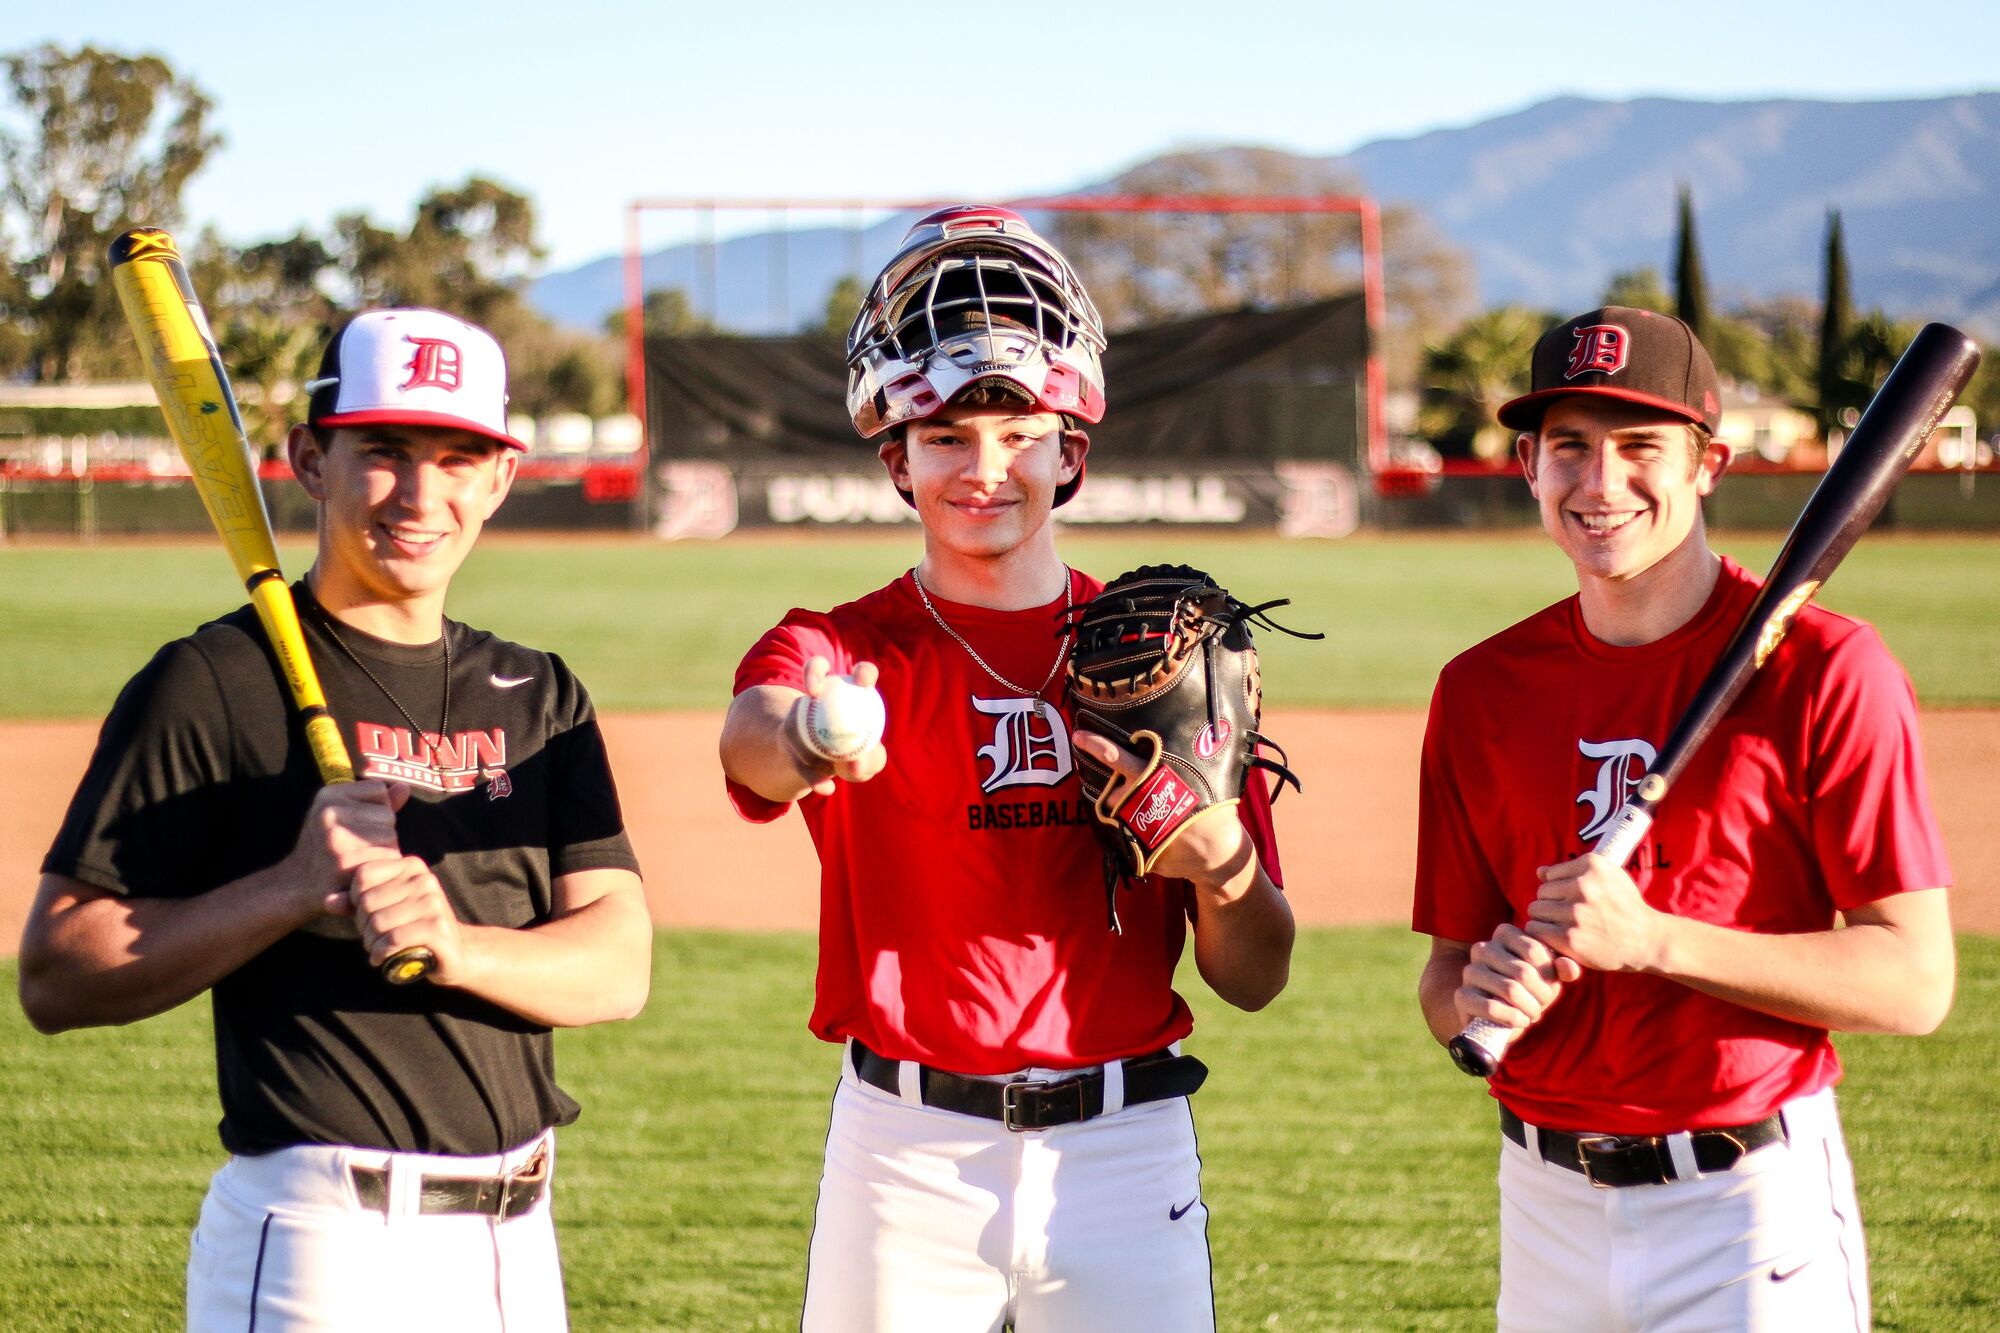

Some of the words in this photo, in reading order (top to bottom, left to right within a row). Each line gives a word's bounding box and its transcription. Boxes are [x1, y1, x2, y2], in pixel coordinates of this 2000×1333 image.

[397, 334, 463, 393] D
[1564, 325, 1629, 381] D
[356, 721, 507, 771] DUNN
[972, 695, 1073, 794] D
[378, 763, 462, 787] BASEBAL
[1137, 780, 1175, 829] Rawlings
